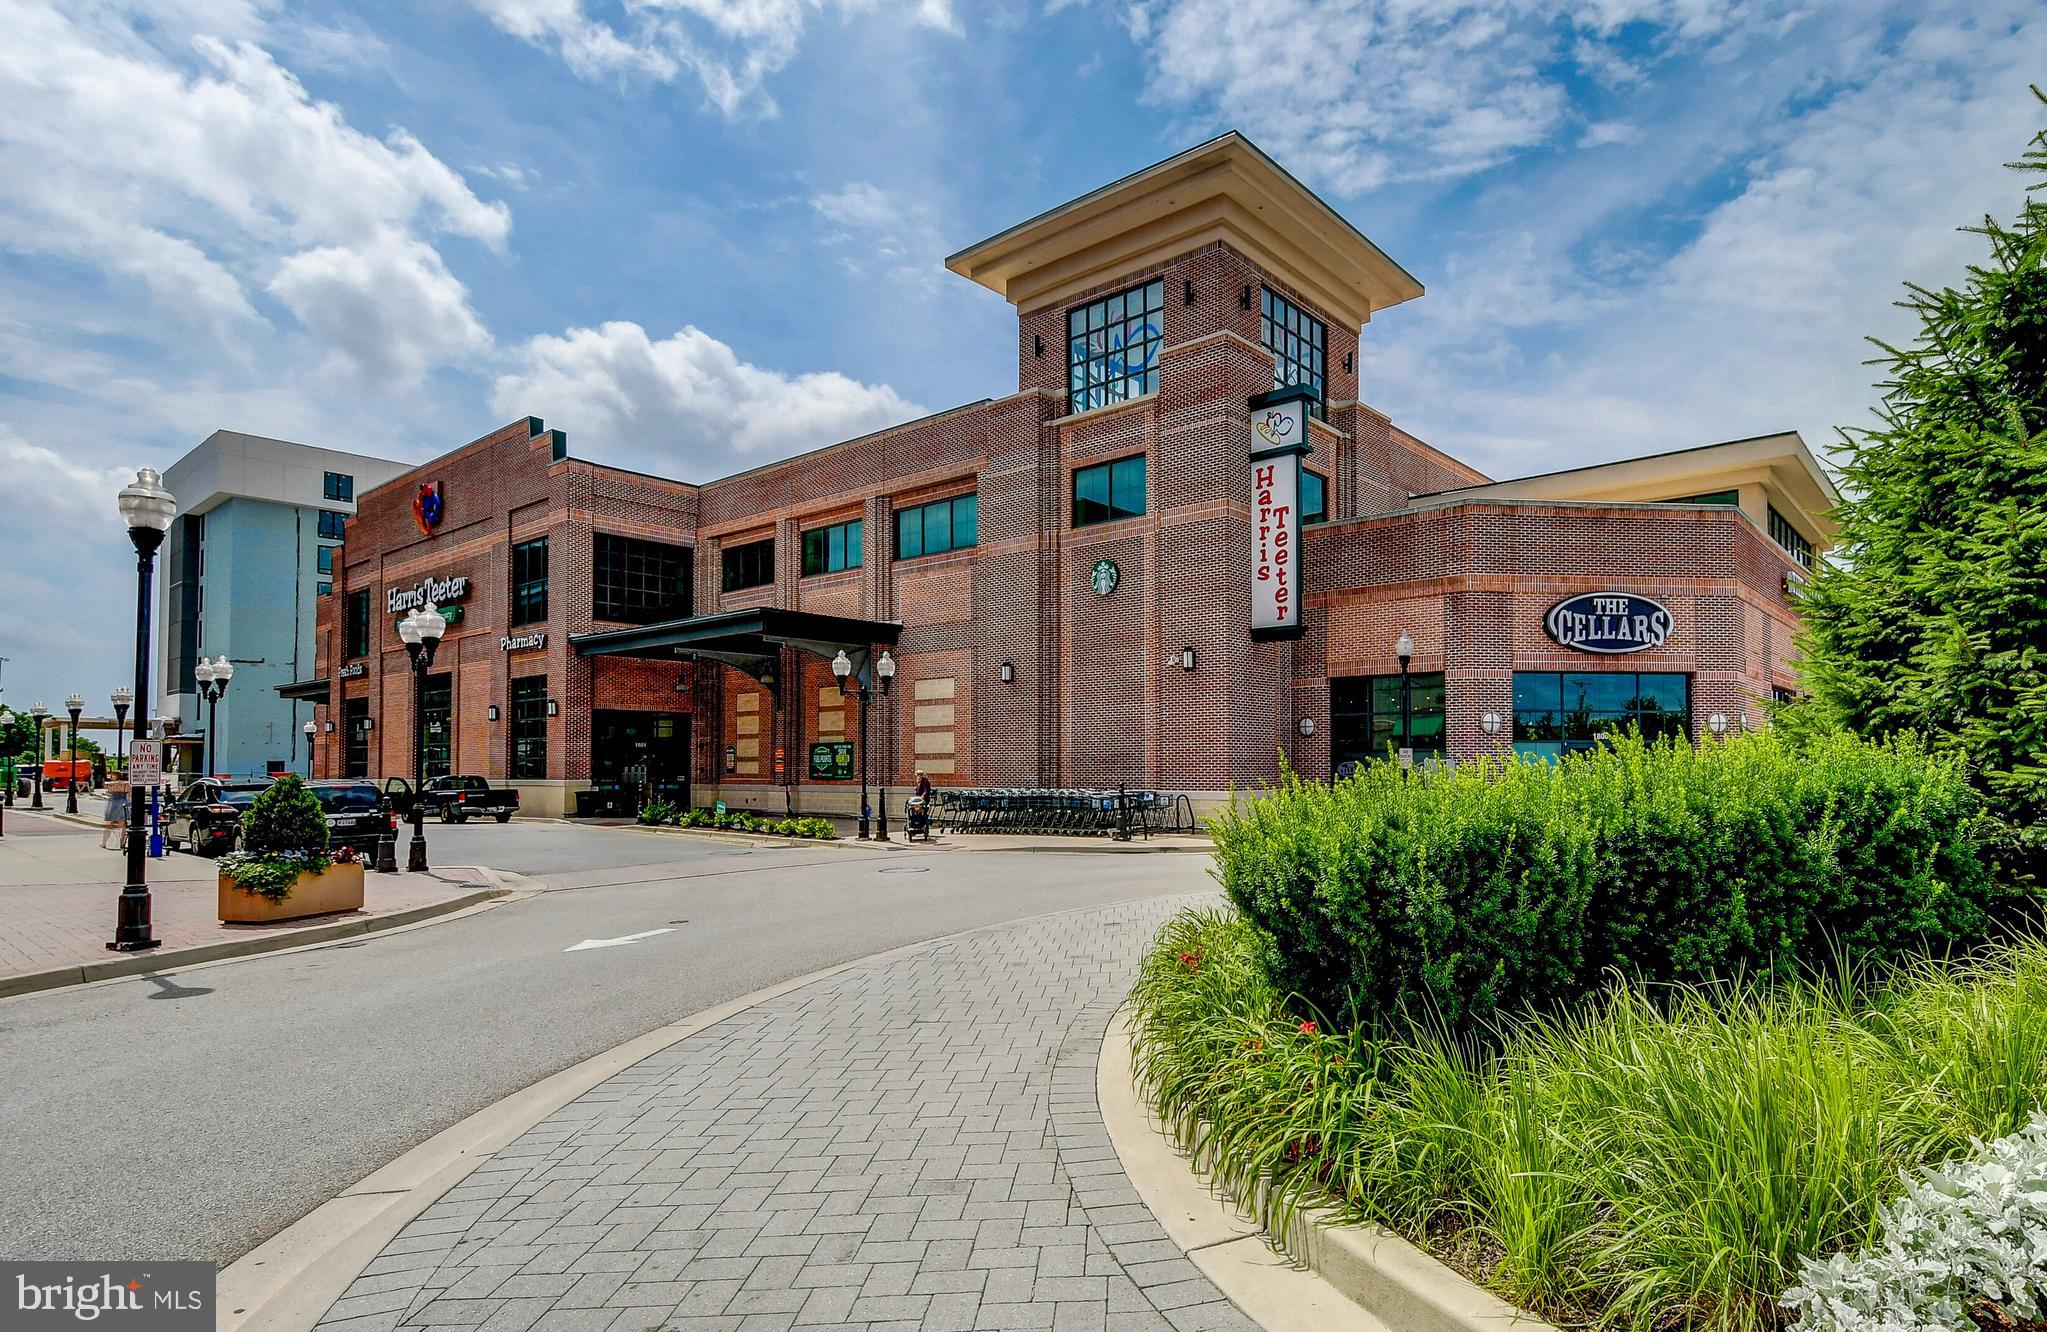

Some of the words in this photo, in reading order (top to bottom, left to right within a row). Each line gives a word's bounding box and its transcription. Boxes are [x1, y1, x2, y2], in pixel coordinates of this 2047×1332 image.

[1255, 465, 1274, 581] Harris
[1273, 505, 1289, 620] Teeter
[387, 583, 424, 613] Harris
[424, 576, 468, 603] Teeter
[1593, 598, 1629, 615] THE
[1558, 609, 1665, 646] CELLARS
[500, 634, 544, 651] Pharmacy
[132, 754, 160, 763] PARKING
[140, 743, 152, 753] NO
